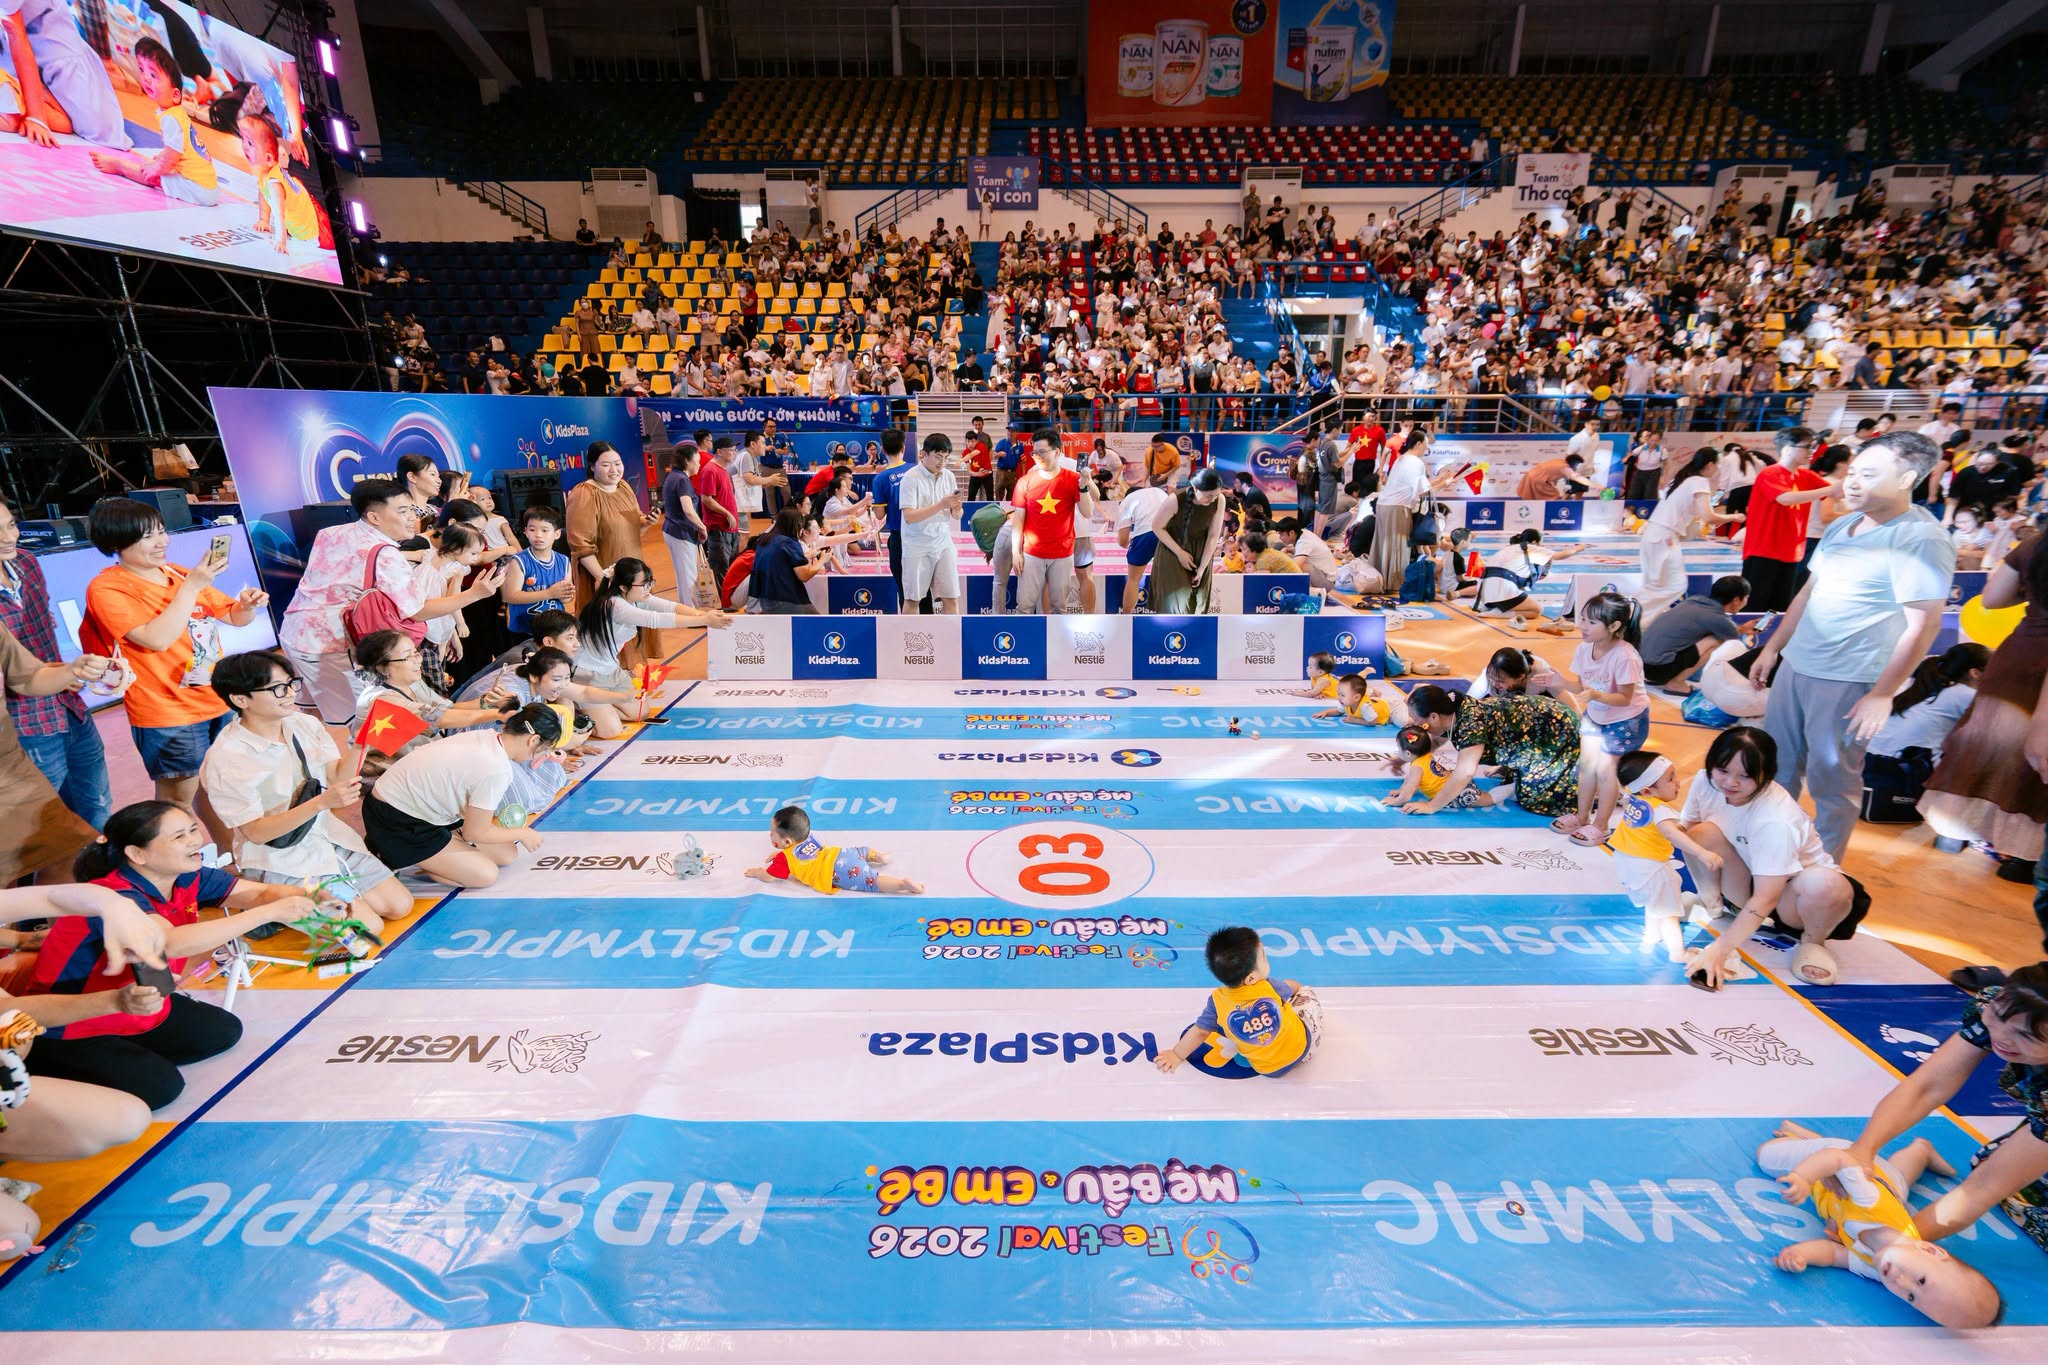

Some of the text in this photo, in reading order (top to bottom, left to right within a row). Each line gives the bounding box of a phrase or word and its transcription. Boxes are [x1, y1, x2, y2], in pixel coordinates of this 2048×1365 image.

[1121, 47, 1153, 58] NAN
[1161, 39, 1201, 54] NAN
[1209, 47, 1240, 58] NAN
[977, 175, 1004, 186] Team
[1532, 173, 1559, 183] Team
[1003, 191, 1032, 203] con
[1518, 184, 1572, 201] Thỏ co
[685, 408, 724, 422] VỮNG
[726, 407, 765, 422] BƯỚC
[767, 407, 795, 422] LỚN
[797, 407, 841, 422] KHÔN!
[555, 424, 590, 438] KidsPlaza
[541, 450, 585, 470] Festival
[1256, 606, 1281, 614] KidsP
[735, 655, 765, 665] Nestlé
[808, 655, 859, 665] KidsPlaza
[904, 655, 934, 665] Nestlé
[978, 655, 1028, 665] KidsPlaza
[1074, 655, 1105, 665] Nestlé
[1148, 655, 1199, 665] KidsPlaza
[1244, 655, 1275, 665] Nestlé
[714, 689, 785, 698] Nestlé
[953, 688, 1086, 698] KidsPlaza
[675, 714, 924, 730] KIDSLYMPIC
[965, 723, 1010, 731] 2026
[641, 754, 732, 766] Nestlé
[938, 751, 1099, 763] KidsPlaza
[1306, 752, 1391, 762] Nestlé
[950, 790, 986, 804] Bé
[585, 796, 898, 816] KIDSLYMPIC
[948, 804, 1097, 816] Festival 2026
[800, 841, 818, 856] 550
[529, 855, 650, 871] Nestlé
[1386, 849, 1503, 866] Nestlé
[925, 917, 975, 942] Bé
[433, 925, 856, 959] KIDSLYMPIC
[922, 943, 1122, 961] Festival 2026
[1242, 1012, 1273, 1034] 486
[325, 1033, 502, 1064] Nestlé
[867, 1031, 1159, 1065] KidsPlaza
[1529, 1026, 1699, 1057] Nestlé
[876, 1164, 949, 1216] Bé
[130, 1176, 773, 1249] KIDSLYMPIC
[868, 1224, 1174, 1259] Festival 2026
